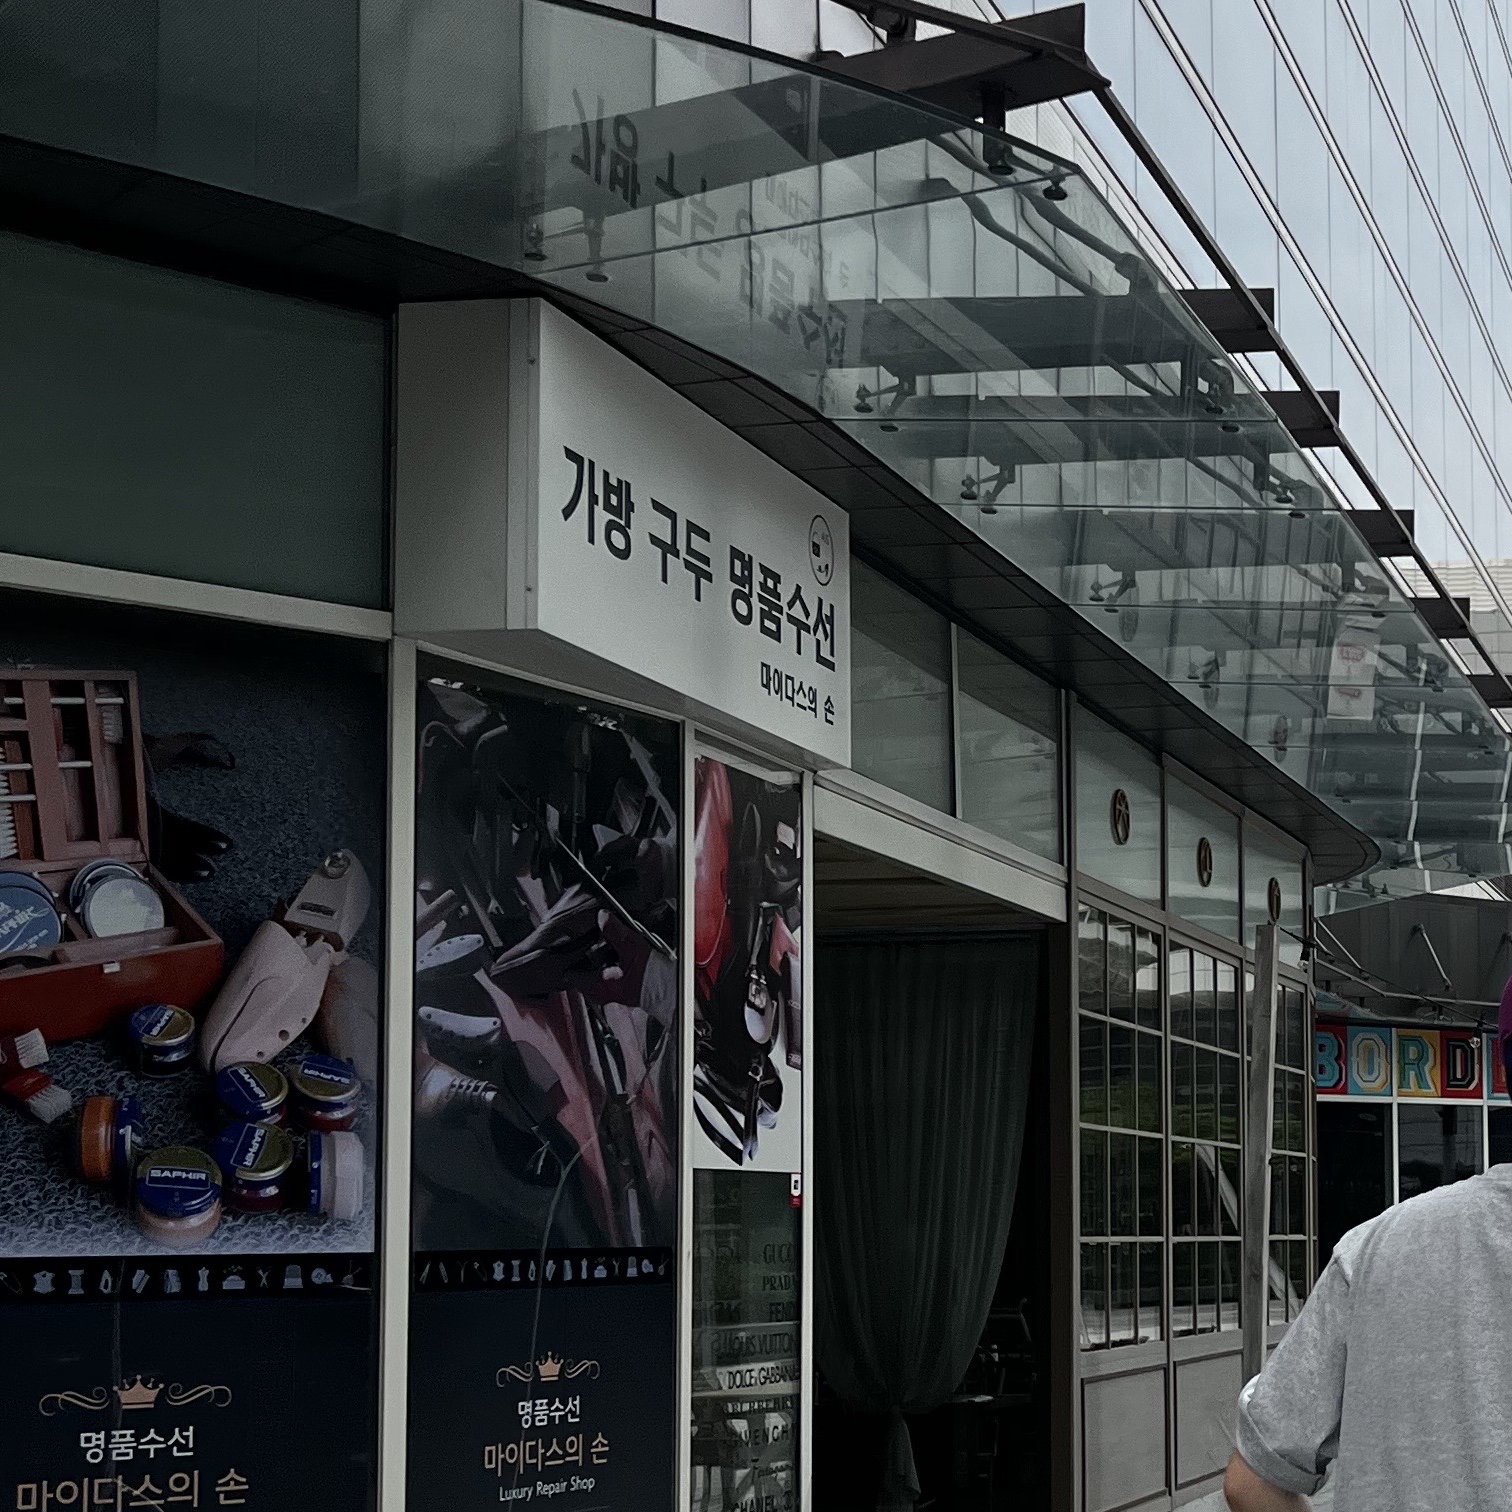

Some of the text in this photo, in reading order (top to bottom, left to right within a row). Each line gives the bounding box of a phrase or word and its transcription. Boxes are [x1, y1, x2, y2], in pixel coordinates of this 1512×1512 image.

[560, 445, 837, 672] 가방 구두 명품수선
[760, 661, 835, 726] 마이다스의 손
[1316, 1031, 1508, 1096] BORD
[149, 1168, 207, 1181] SAPHIR
[517, 1395, 581, 1428] 명품수선
[79, 1425, 195, 1463] 명품수선
[484, 1431, 610, 1477] 마이다스의 손
[215, 1467, 250, 1507] 손
[499, 1475, 595, 1503] Luxury Repair Shop
